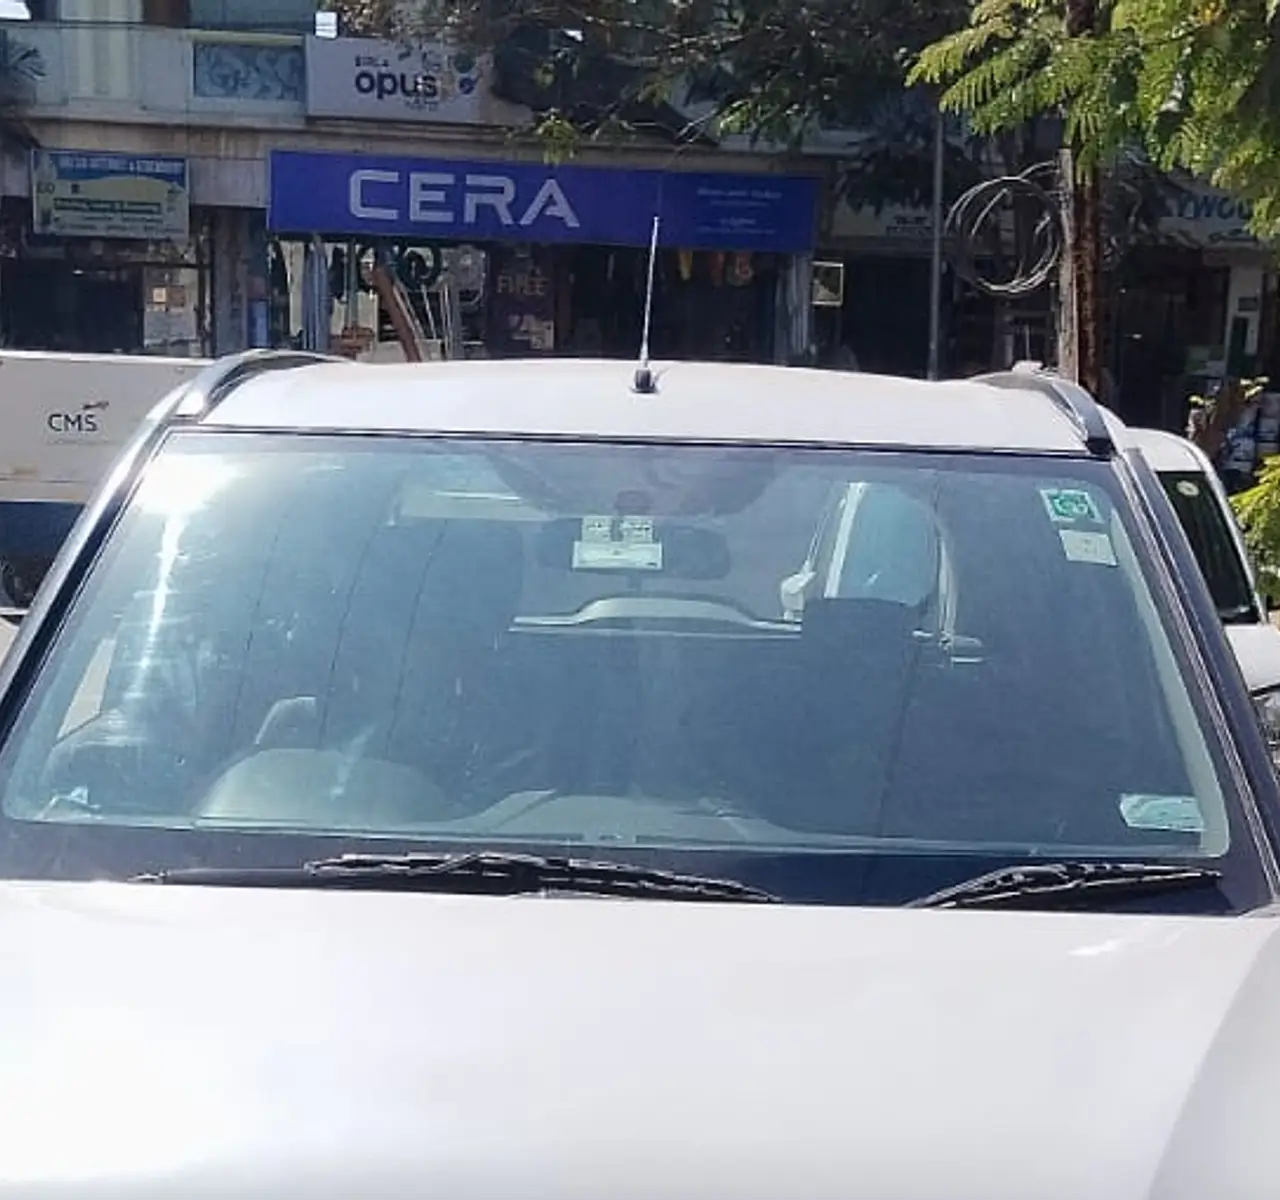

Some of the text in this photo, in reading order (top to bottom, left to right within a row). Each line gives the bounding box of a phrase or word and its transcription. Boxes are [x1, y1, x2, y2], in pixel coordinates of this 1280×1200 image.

[354, 70, 439, 99] opus
[349, 169, 581, 228] CERA
[47, 413, 98, 432] CMS
